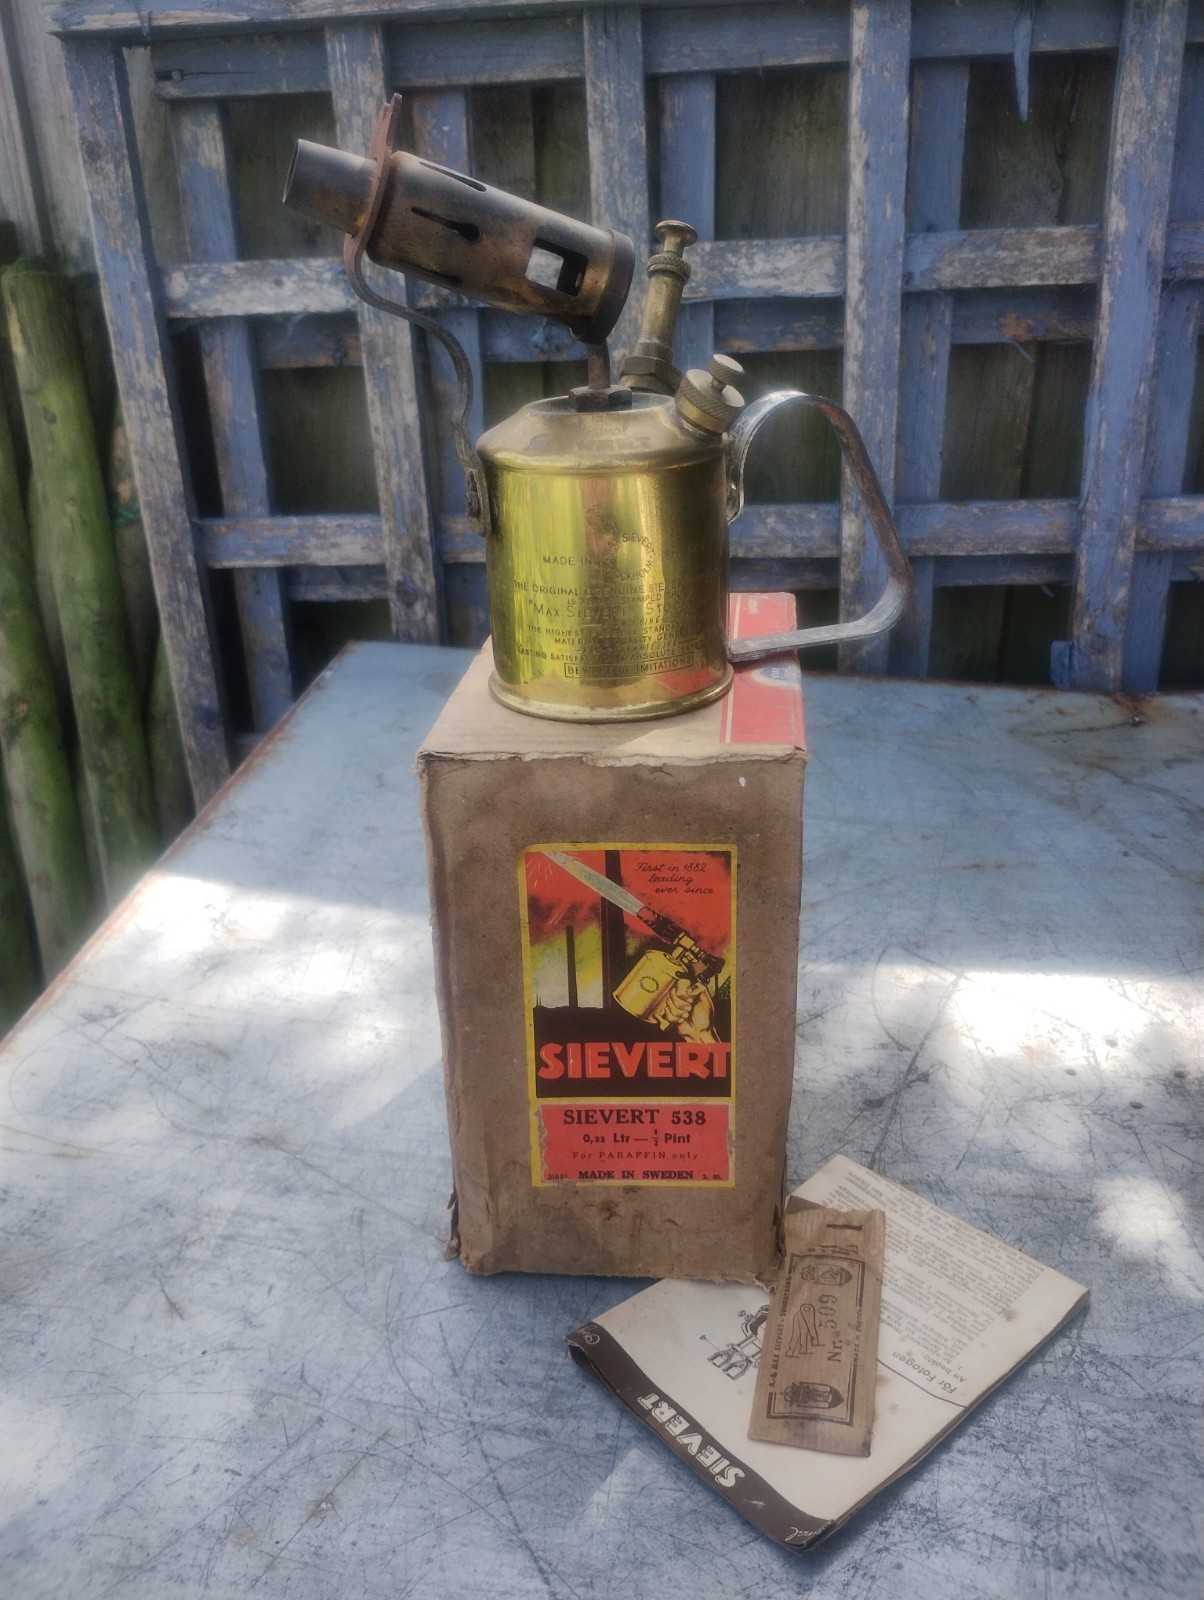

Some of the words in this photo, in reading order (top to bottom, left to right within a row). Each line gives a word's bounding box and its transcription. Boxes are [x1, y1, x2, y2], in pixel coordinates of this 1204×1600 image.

[543, 554, 575, 566] MADE
[581, 556, 593, 566] IN
[532, 583, 580, 597] ORIGINAL
[620, 593, 662, 605] STAMPED
[545, 627, 584, 637] HIGHEST
[630, 647, 676, 662] ABSOLUTE
[635, 654, 693, 673] IMITATIONS
[634, 861, 664, 873] First
[667, 863, 679, 872] in
[683, 861, 708, 873] 1882
[648, 873, 694, 887] leading
[655, 886, 679, 894] ever
[684, 886, 714, 895] since
[537, 1041, 731, 1080] SIEVERT
[563, 1108, 660, 1126] SIEVERT
[670, 1110, 706, 1126] 538
[613, 1132, 631, 1144] Ltr
[664, 1132, 692, 1144] Pint
[572, 1151, 593, 1160] For
[598, 1151, 667, 1160] PARAFFIN
[671, 1151, 699, 1161] only
[578, 1170, 615, 1179] MADE
[621, 1170, 635, 1179] IN
[642, 1170, 694, 1179] SWEDEN
[816, 1293, 839, 1330] 509
[775, 1324, 785, 1353] SIEVERT
[826, 1338, 844, 1364] Nr.
[892, 1350, 937, 1383] Fotogen
[937, 1379, 958, 1394] För
[636, 1391, 746, 1488] SIEVERT
